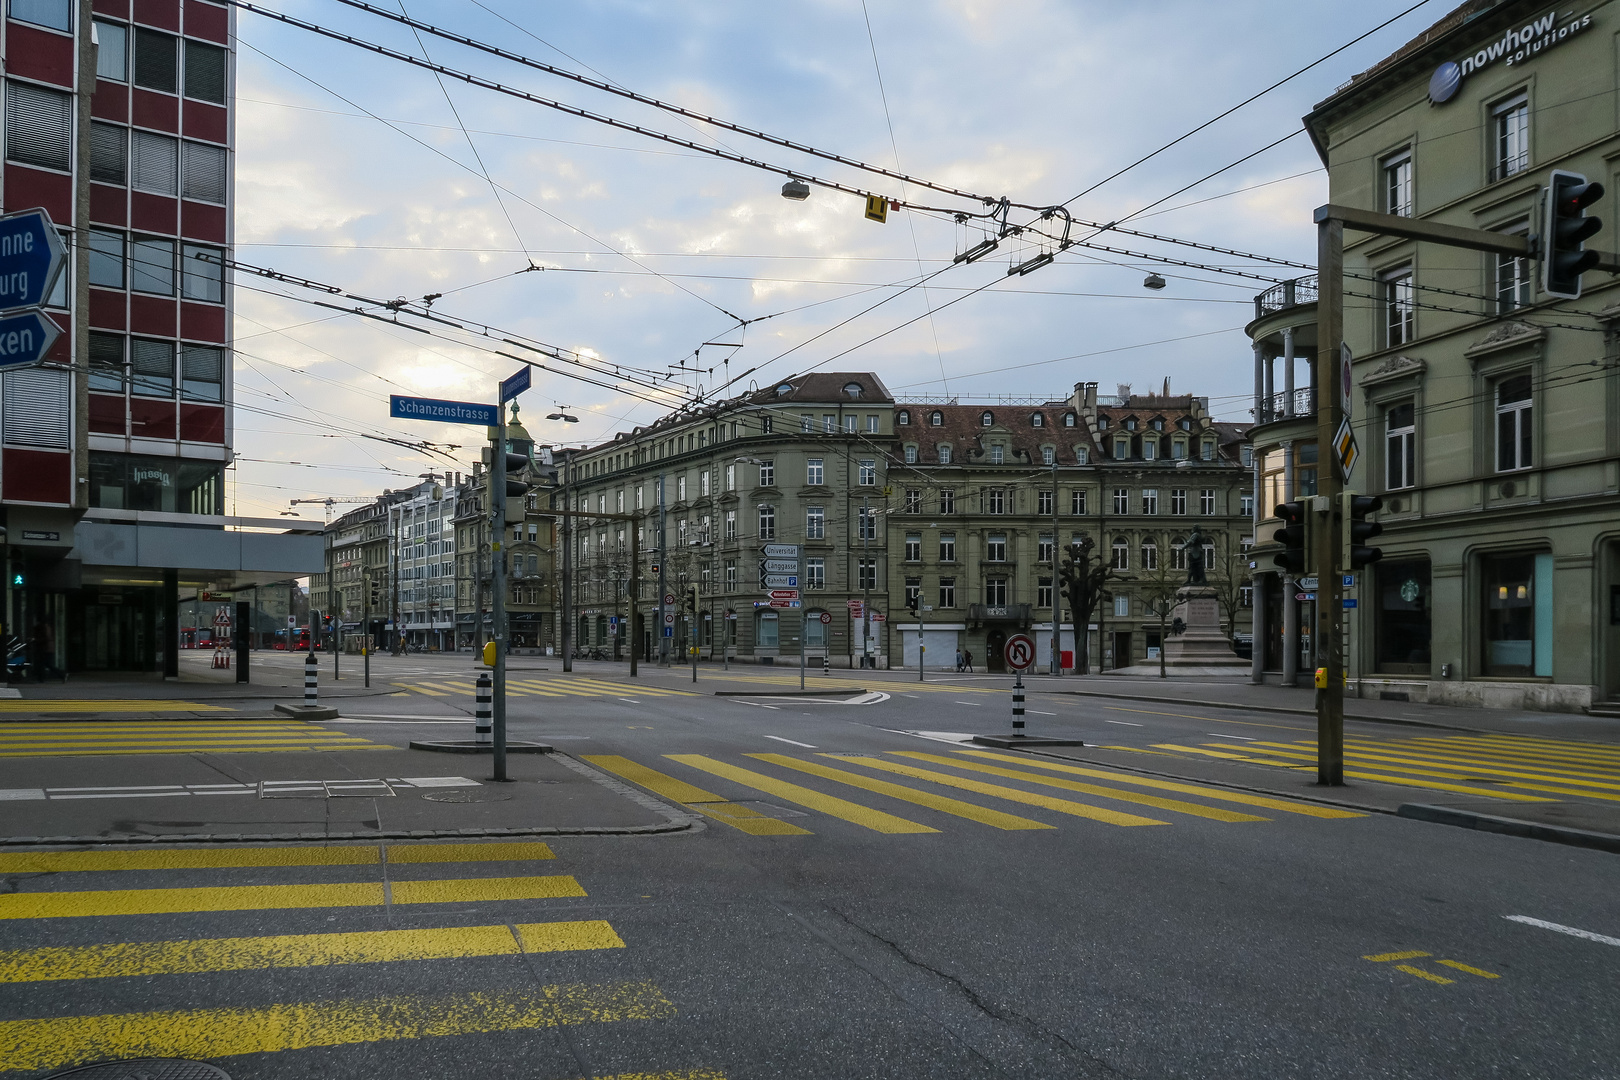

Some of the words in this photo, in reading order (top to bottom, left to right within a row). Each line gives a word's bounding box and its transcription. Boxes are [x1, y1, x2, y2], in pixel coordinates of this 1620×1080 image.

[1461, 11, 1556, 76] nowhow
[1506, 14, 1592, 66] solutions
[2, 231, 33, 257] nne
[399, 400, 489, 420] Schanzenstrasse
[767, 561, 797, 570] Länggasse
